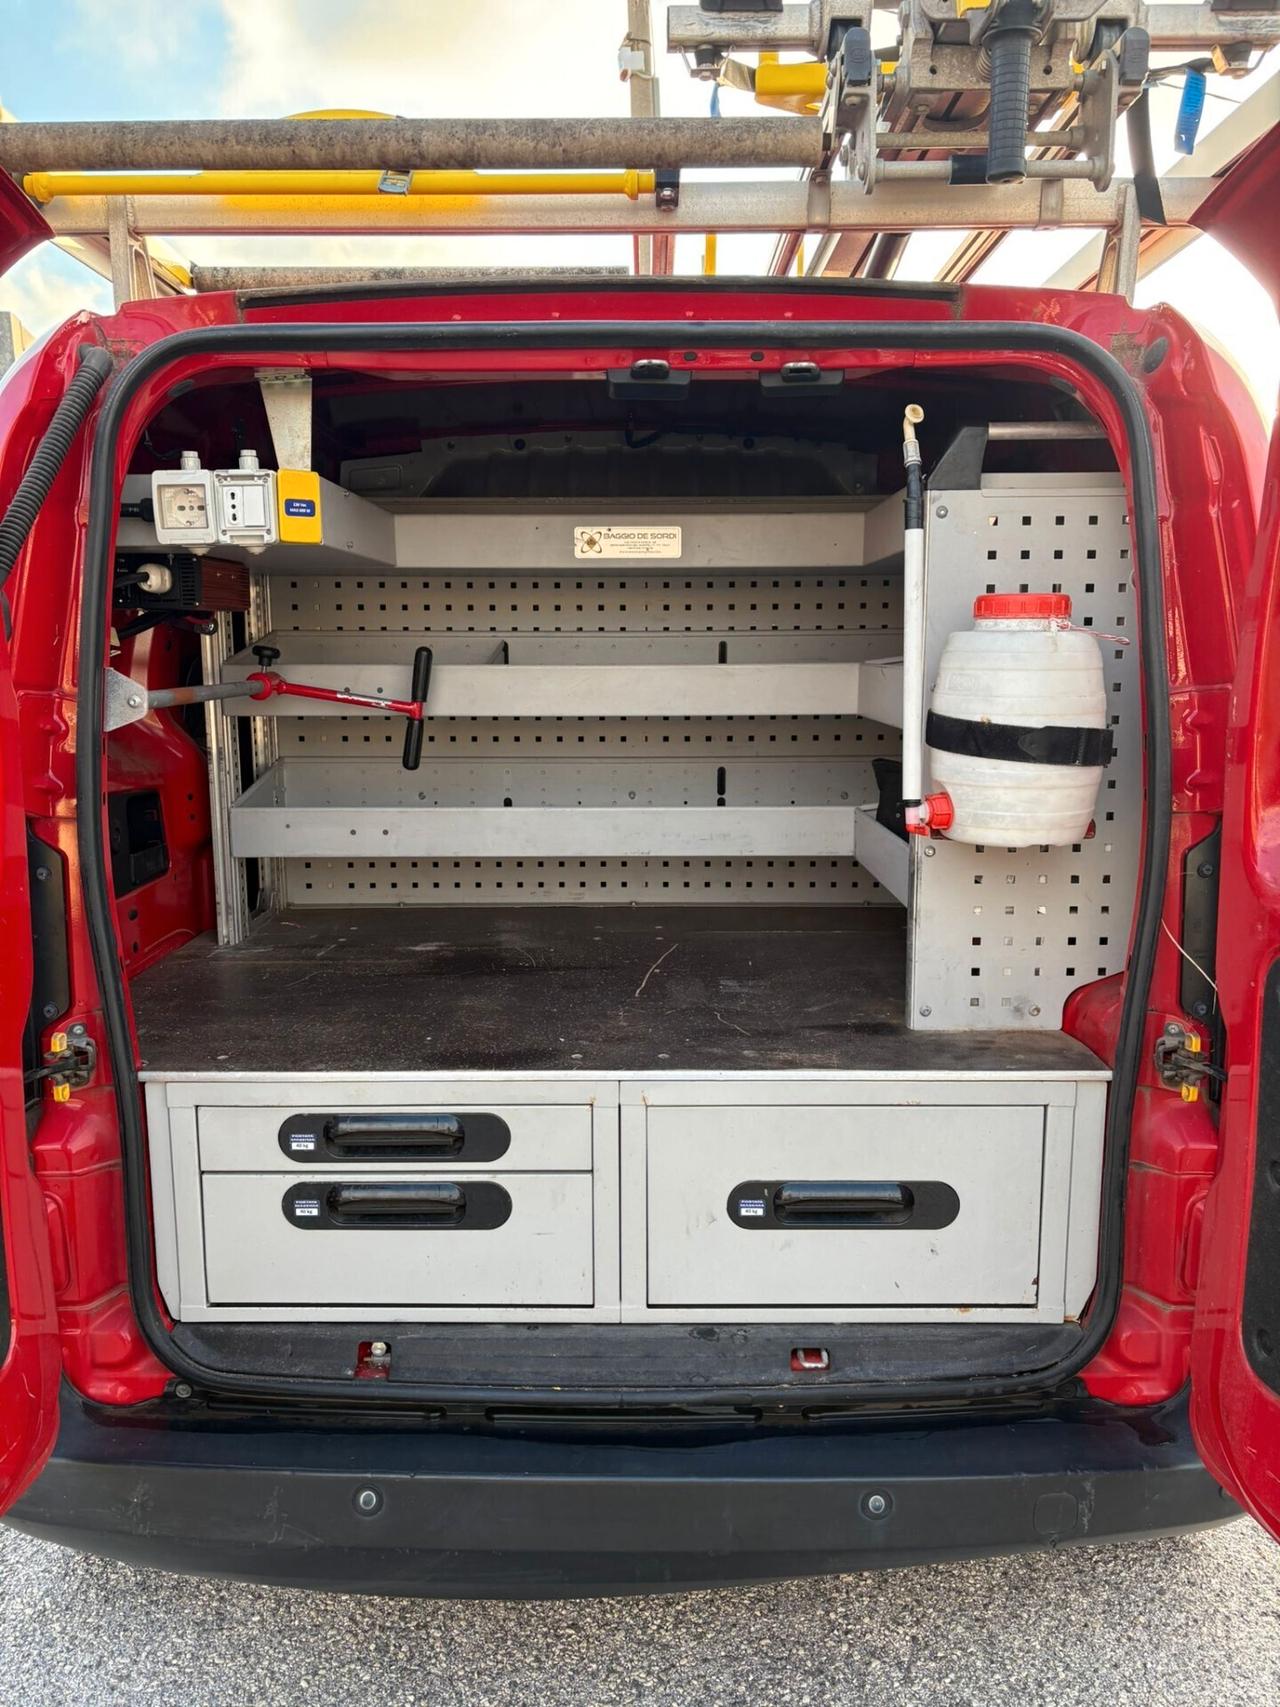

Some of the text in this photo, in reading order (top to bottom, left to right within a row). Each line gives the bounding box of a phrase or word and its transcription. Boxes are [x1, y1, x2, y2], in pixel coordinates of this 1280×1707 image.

[603, 532, 677, 540] BAGGIO DE SORDI
